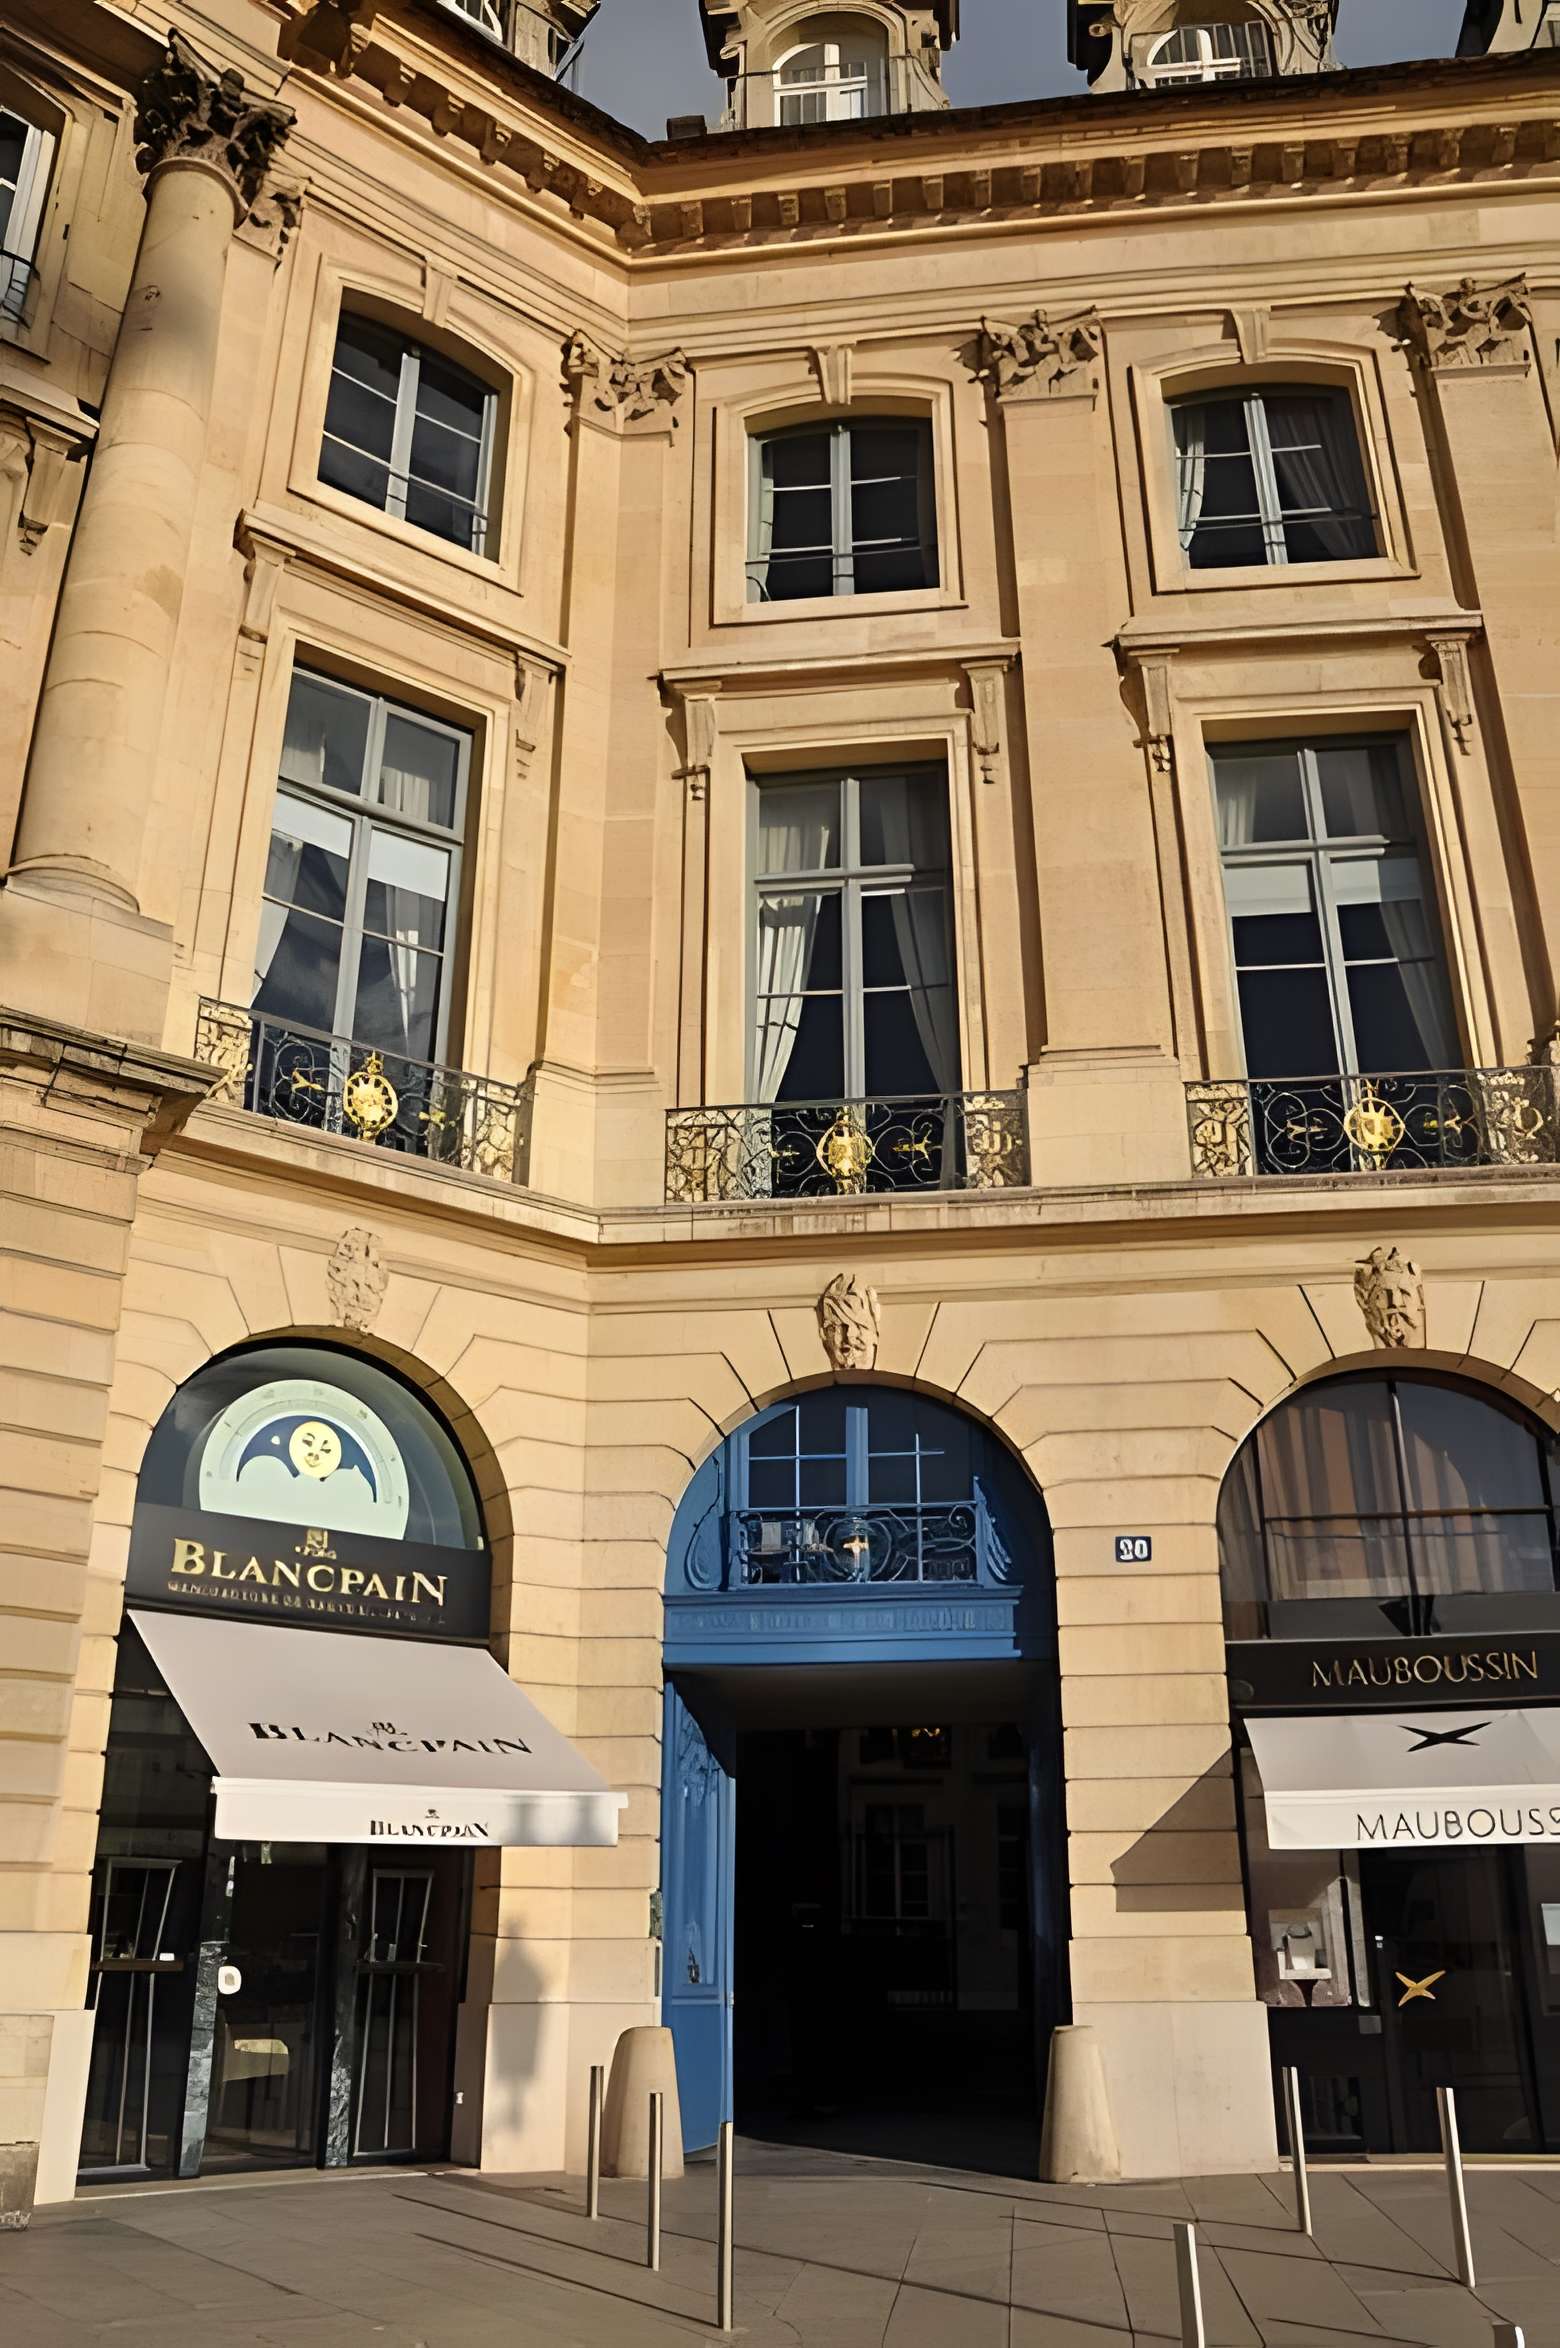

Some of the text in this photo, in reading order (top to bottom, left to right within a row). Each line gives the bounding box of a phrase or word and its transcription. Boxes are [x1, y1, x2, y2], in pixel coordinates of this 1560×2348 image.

[171, 1538, 448, 1607] BLANCPAIN
[1312, 1650, 1538, 1688] MAUBOUSSIN
[249, 1723, 533, 1754] BLANCPAIN
